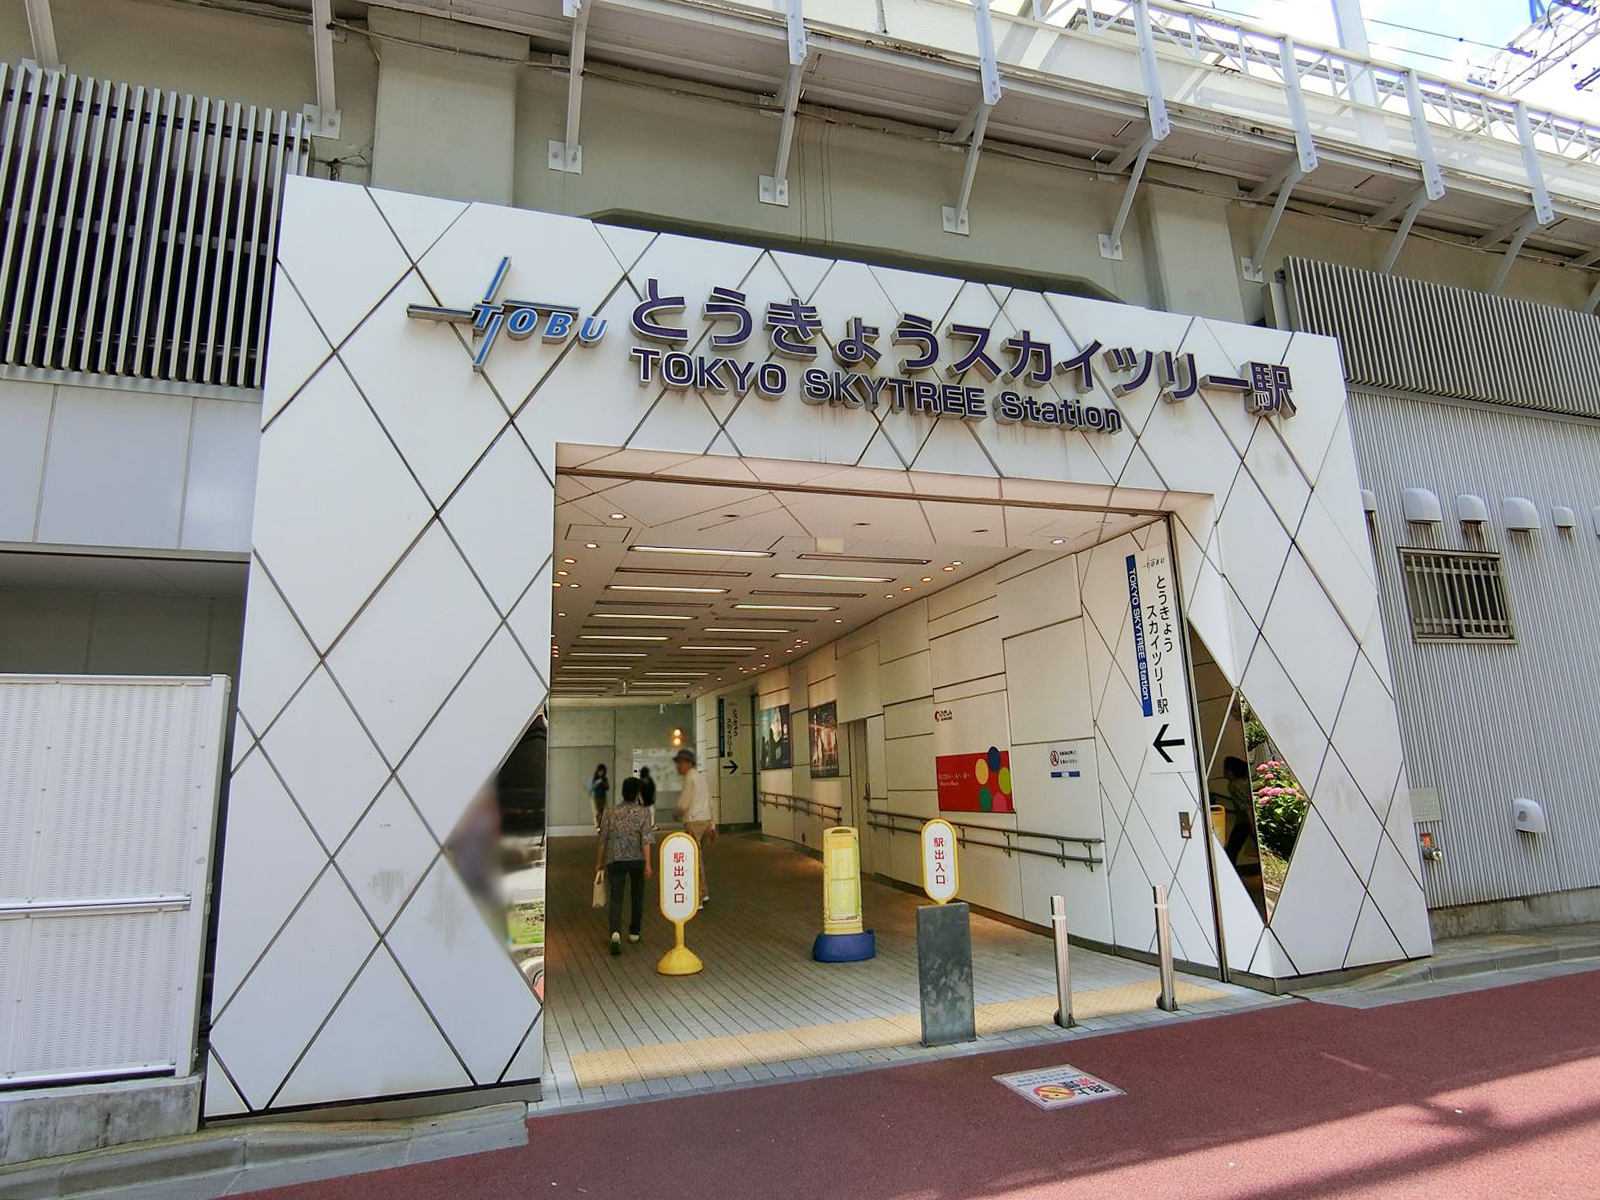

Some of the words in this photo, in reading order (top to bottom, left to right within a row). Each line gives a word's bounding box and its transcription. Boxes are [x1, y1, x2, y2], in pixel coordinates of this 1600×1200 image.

[629, 277, 1297, 417] とうきょうスカイツリー駅
[630, 346, 787, 400] TOKYO
[801, 367, 988, 421] SKYTREE
[994, 389, 1123, 435] Station
[1128, 567, 1140, 606] TOKYO
[1132, 607, 1145, 659] SKYTREE
[1156, 575, 1173, 653] とうきょう
[1138, 661, 1149, 700] Station
[1147, 605, 1169, 714] スカイツリー駅
[673, 852, 685, 904] 駅出入口
[934, 837, 946, 885] 駅出入口
